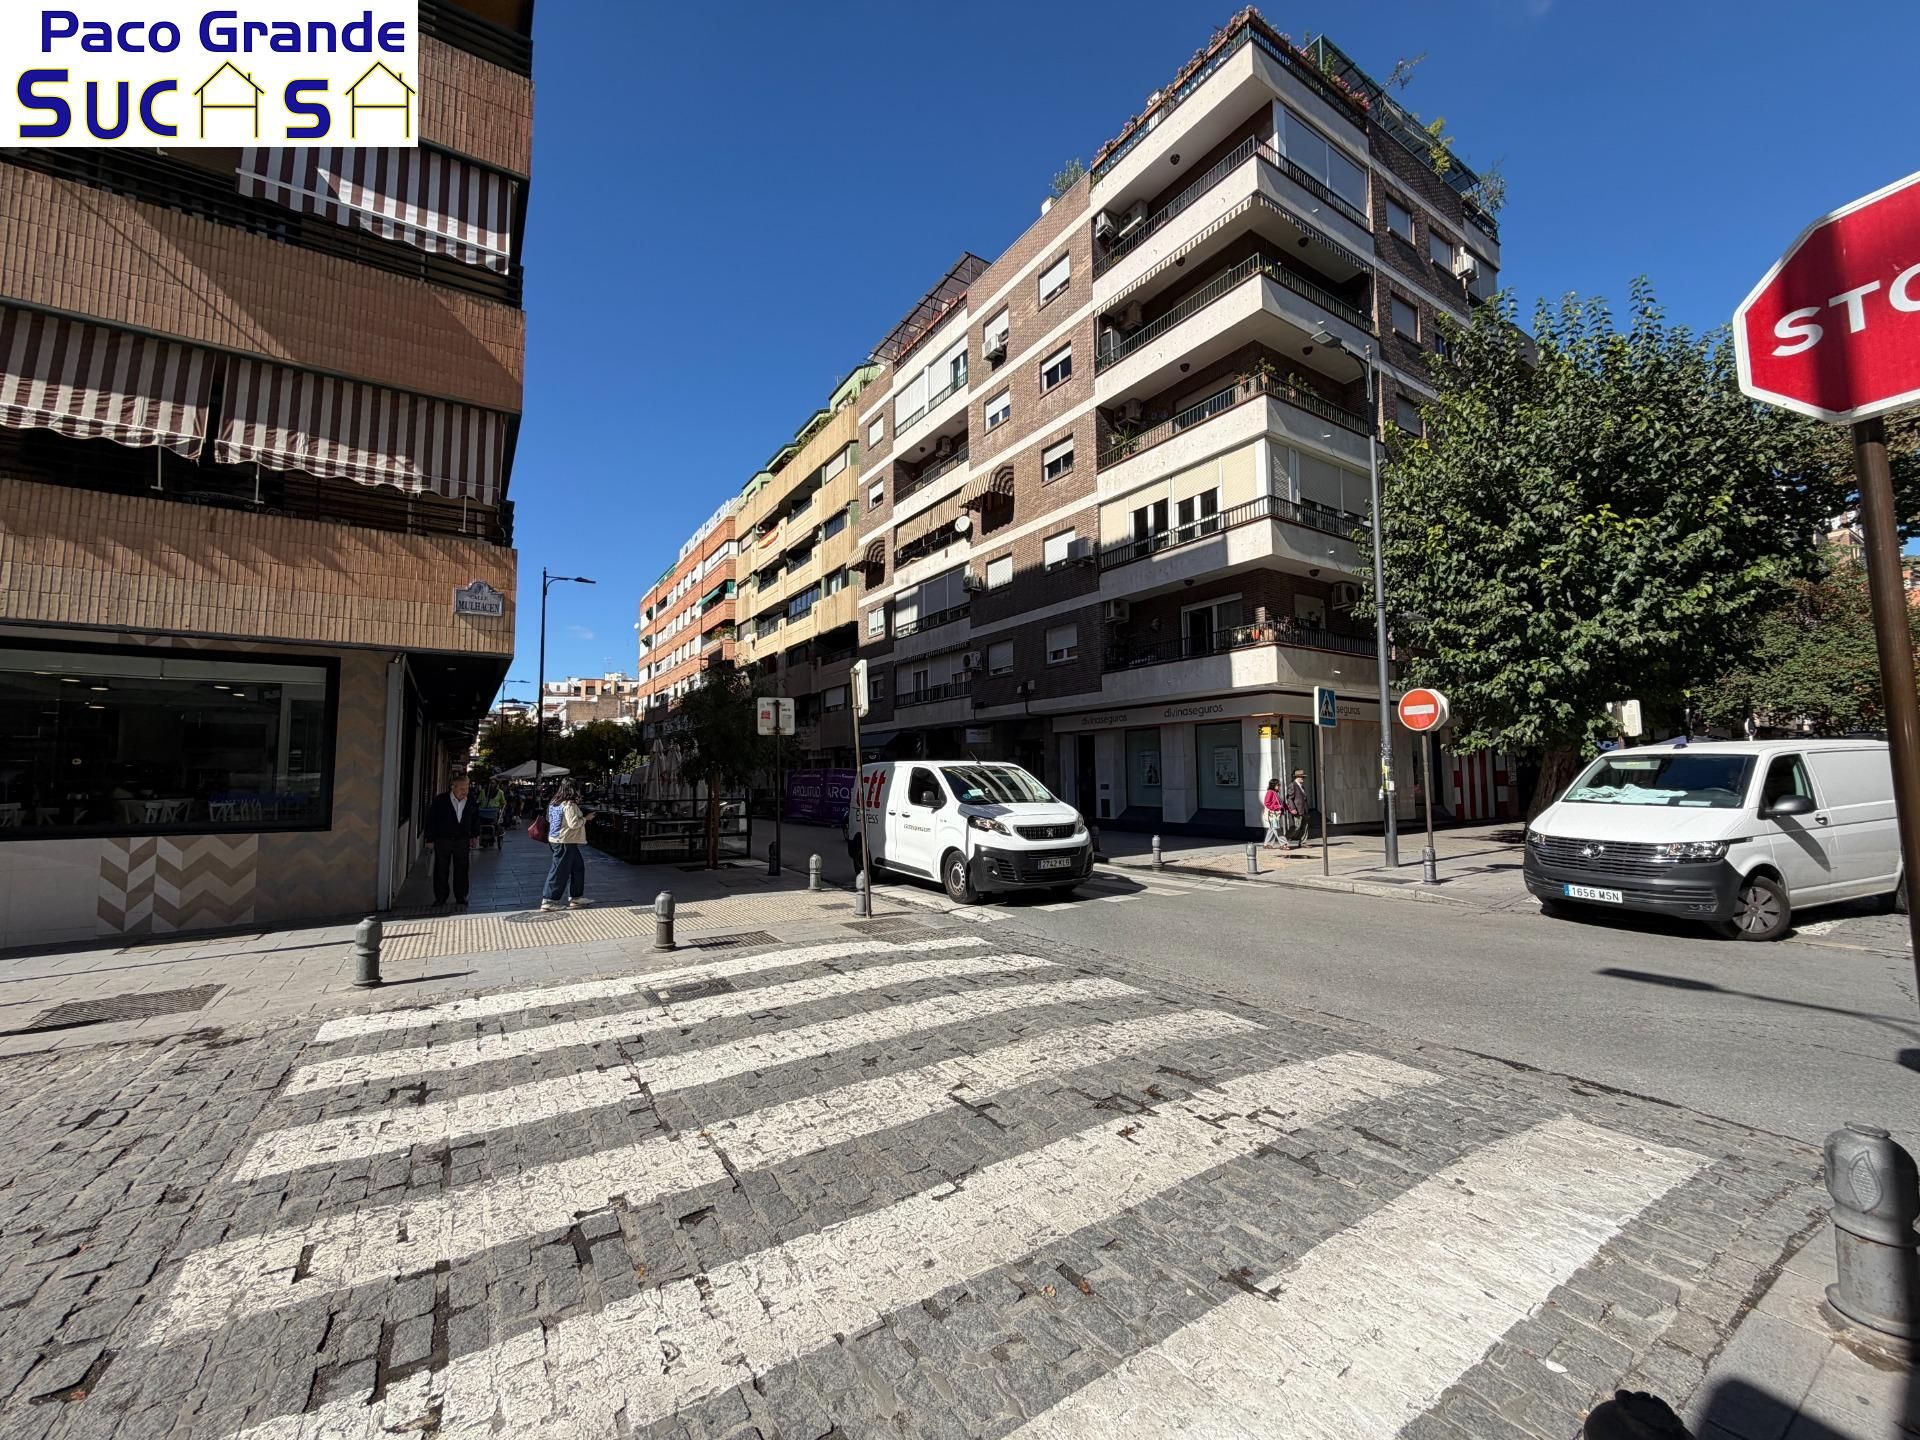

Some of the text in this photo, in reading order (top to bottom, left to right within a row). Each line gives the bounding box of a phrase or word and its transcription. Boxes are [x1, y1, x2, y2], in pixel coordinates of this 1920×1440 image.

[1164, 704, 1224, 718] divinaseguros
[1572, 887, 1620, 901] 1656 MSN
